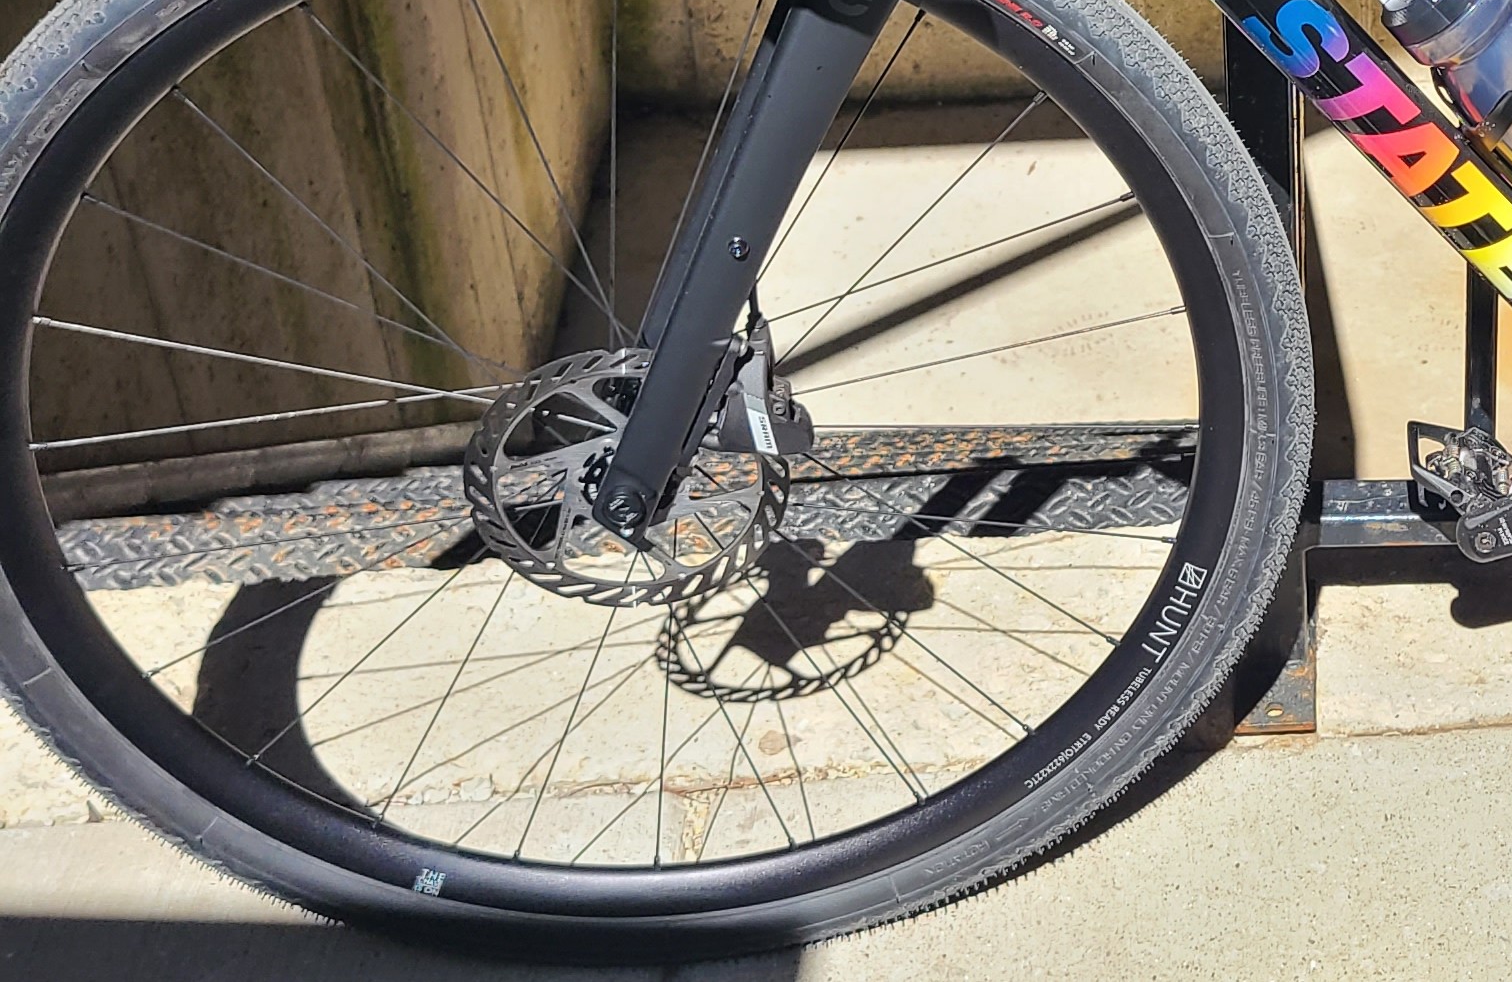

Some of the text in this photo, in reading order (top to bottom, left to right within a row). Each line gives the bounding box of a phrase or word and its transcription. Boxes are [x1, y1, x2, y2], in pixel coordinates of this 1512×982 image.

[758, 415, 773, 449] SRAM
[1141, 585, 1198, 664] HUNT
[1118, 667, 1153, 707] TUBELESS
[1093, 703, 1121, 732] READY
